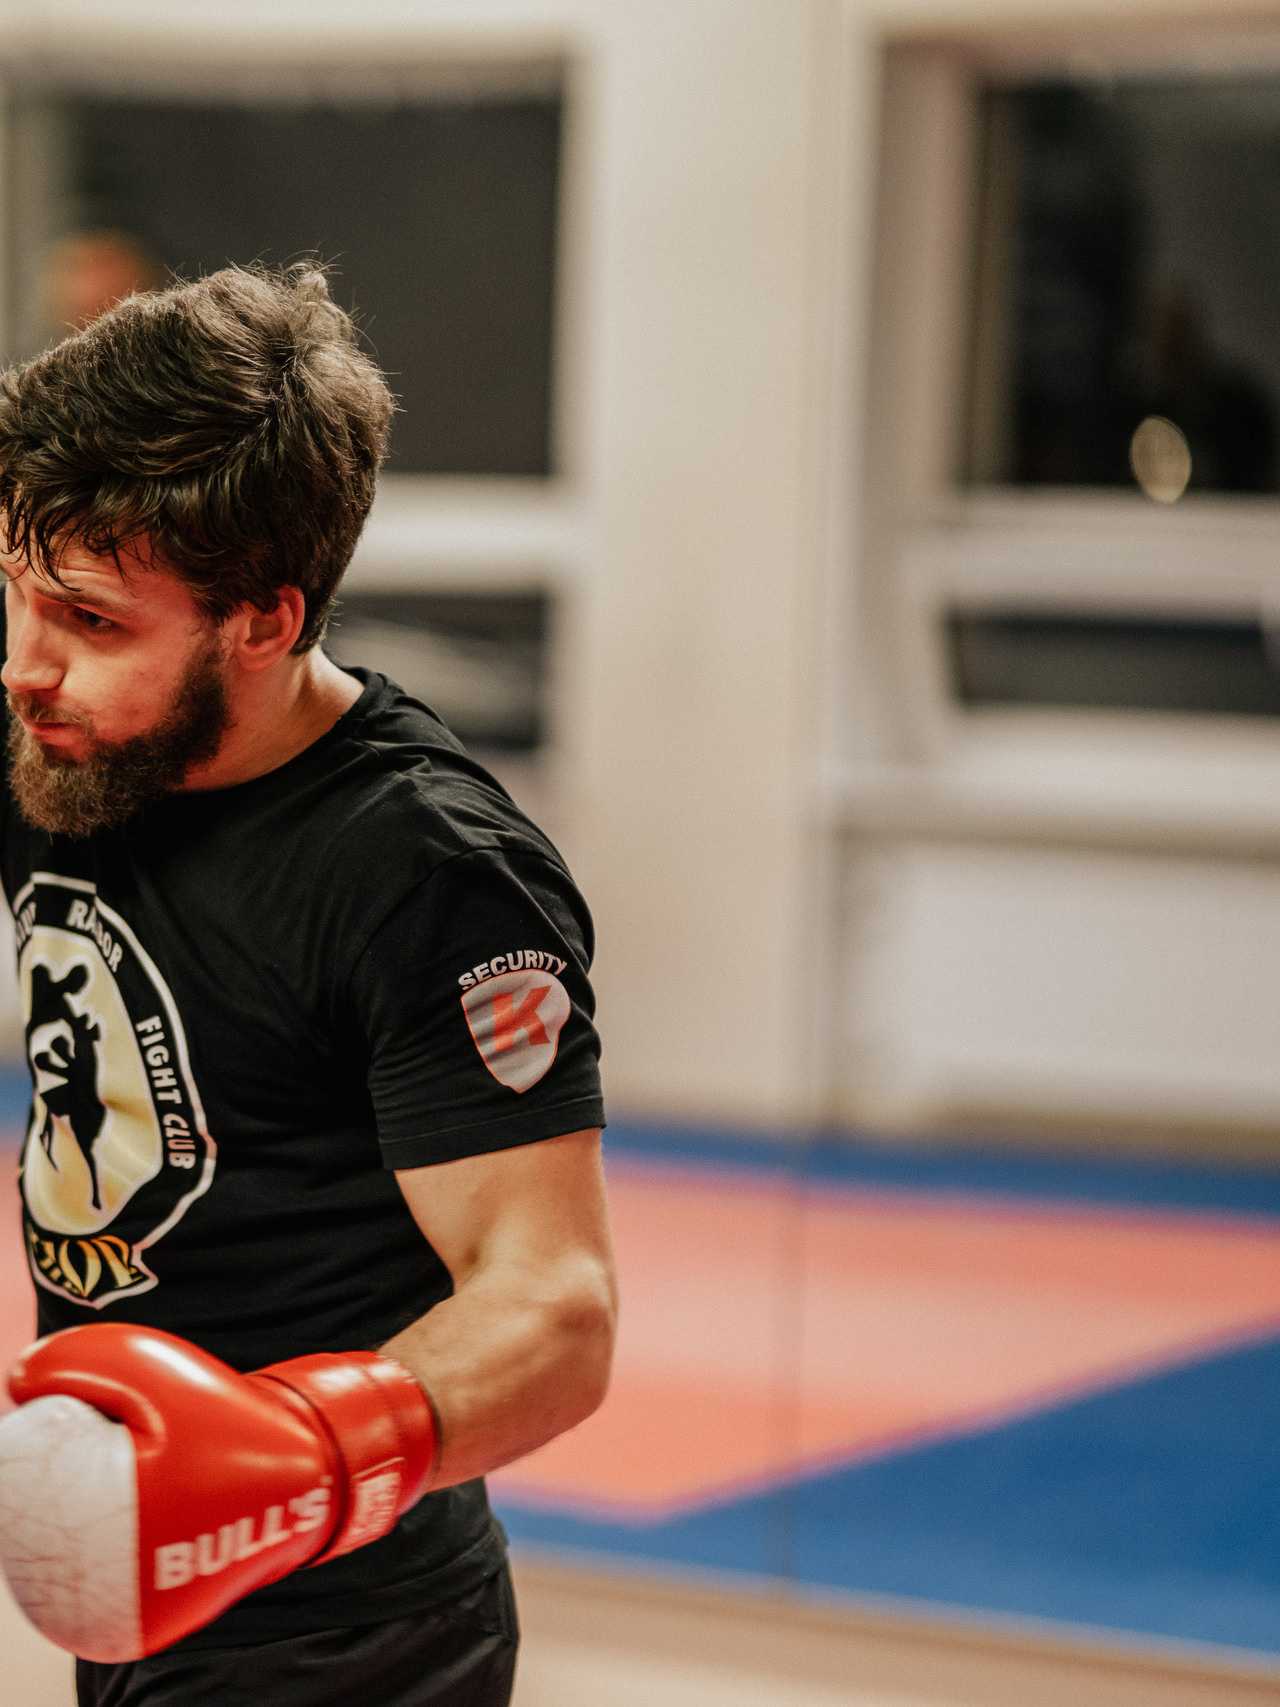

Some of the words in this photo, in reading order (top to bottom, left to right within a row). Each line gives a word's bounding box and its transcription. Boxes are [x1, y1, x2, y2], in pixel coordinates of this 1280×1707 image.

[458, 949, 568, 991] SECURITY
[493, 985, 552, 1053] K
[135, 1015, 182, 1104] FIGHT
[162, 1113, 197, 1169] CLUB
